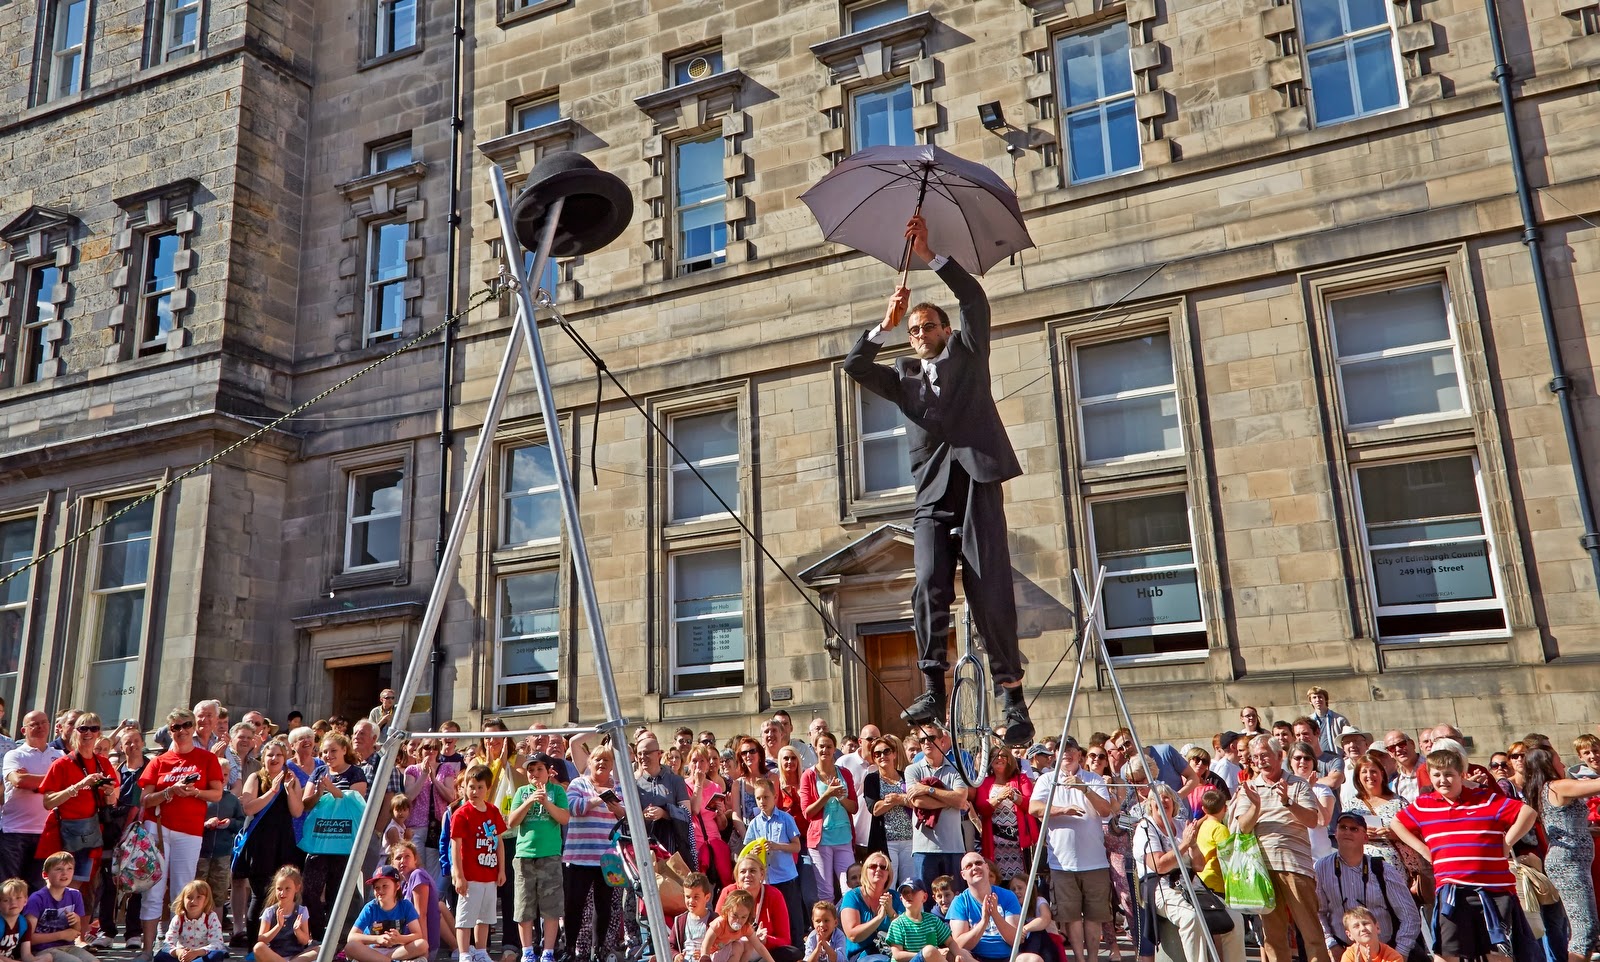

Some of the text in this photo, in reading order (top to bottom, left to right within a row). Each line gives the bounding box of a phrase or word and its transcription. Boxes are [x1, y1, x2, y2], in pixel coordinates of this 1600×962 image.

[1377, 558, 1393, 566] City
[1405, 553, 1450, 562] Edinburgh
[1452, 550, 1483, 558] Council
[1416, 567, 1436, 576] High
[1438, 564, 1464, 572] Street
[1118, 570, 1178, 584] Customer
[1137, 586, 1163, 598] Hub
[476, 838, 490, 848] LIKE
